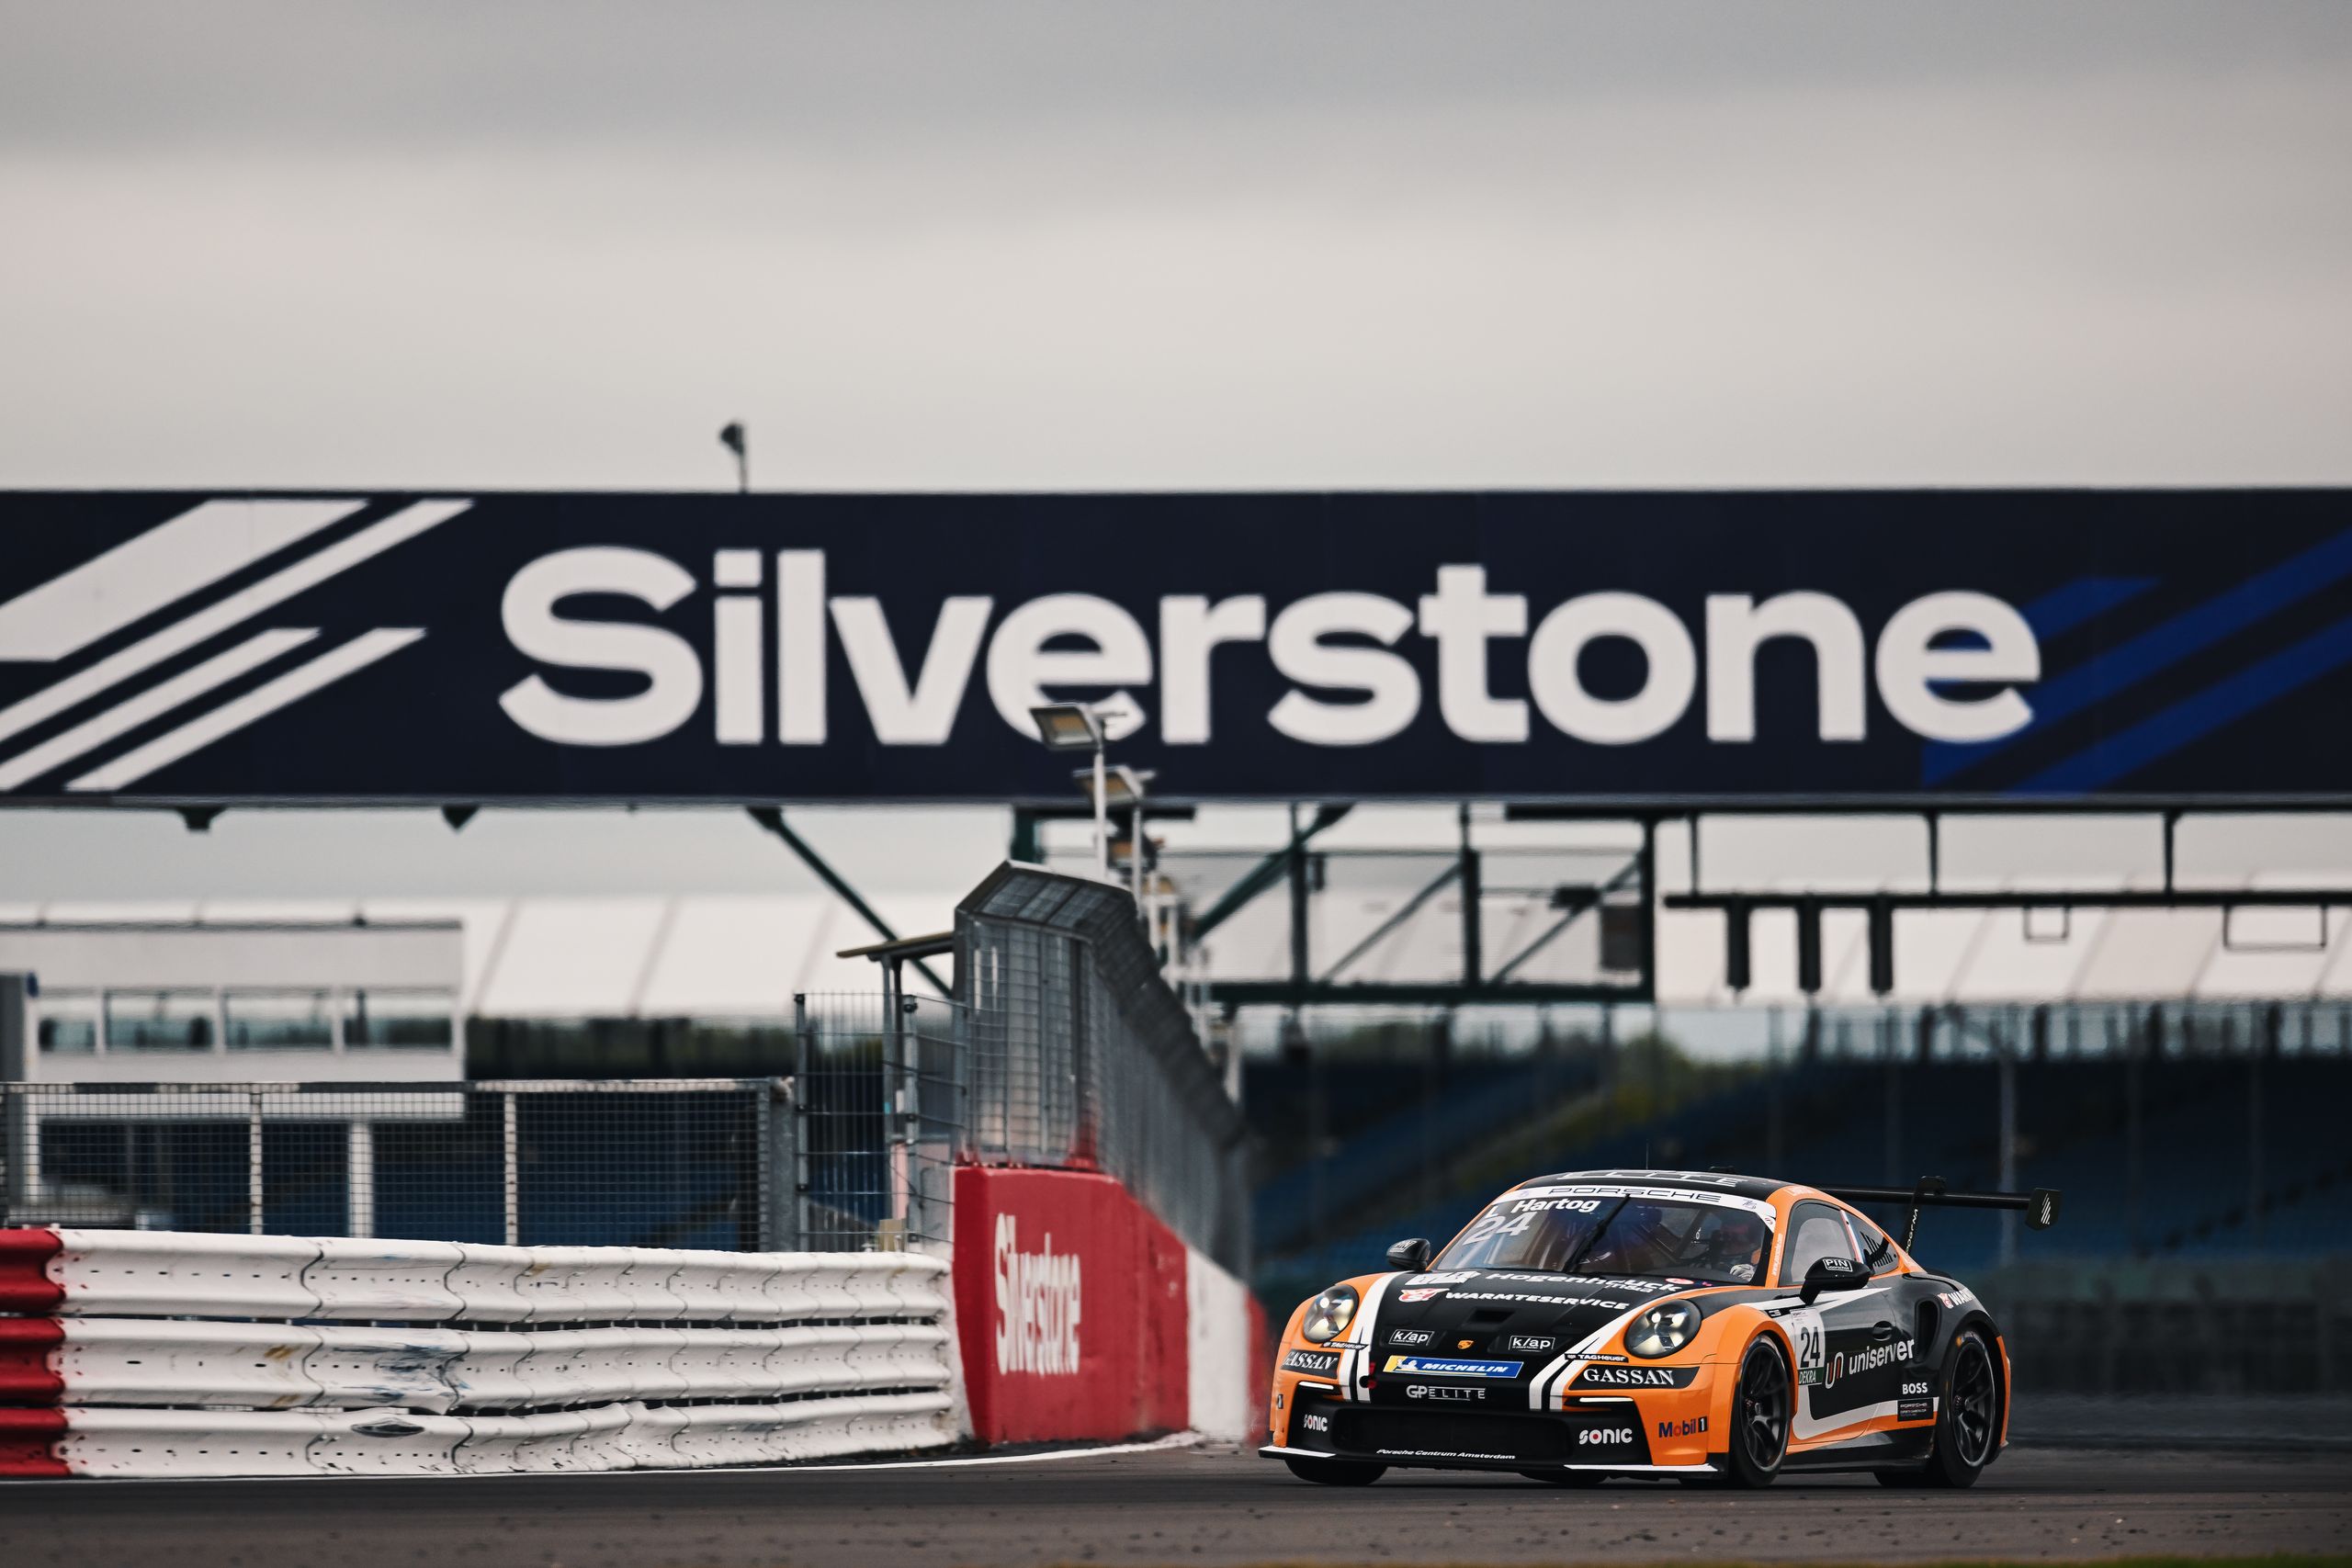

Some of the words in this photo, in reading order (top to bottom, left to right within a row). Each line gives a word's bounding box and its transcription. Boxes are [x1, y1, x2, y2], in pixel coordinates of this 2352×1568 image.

[499, 547, 2041, 747] Silverstone
[1548, 1187, 1723, 1203] PORSCHE
[1510, 1198, 1601, 1213] Hartog
[1463, 1212, 1538, 1246] 24
[1825, 1258, 1849, 1267] PIN
[1445, 1292, 1629, 1310] WARMTESERVICE
[1800, 1326, 1820, 1368] 24
[1849, 1338, 1915, 1375] uniserver
[1421, 1363, 1509, 1373] MICHELIN
[1583, 1369, 1674, 1385] GASSAN
[1798, 1371, 1816, 1384] DEKRA
[1902, 1382, 1928, 1394] BOSS
[1658, 1418, 1696, 1438] Mobil
[1415, 1450, 1456, 1458] Centrum
